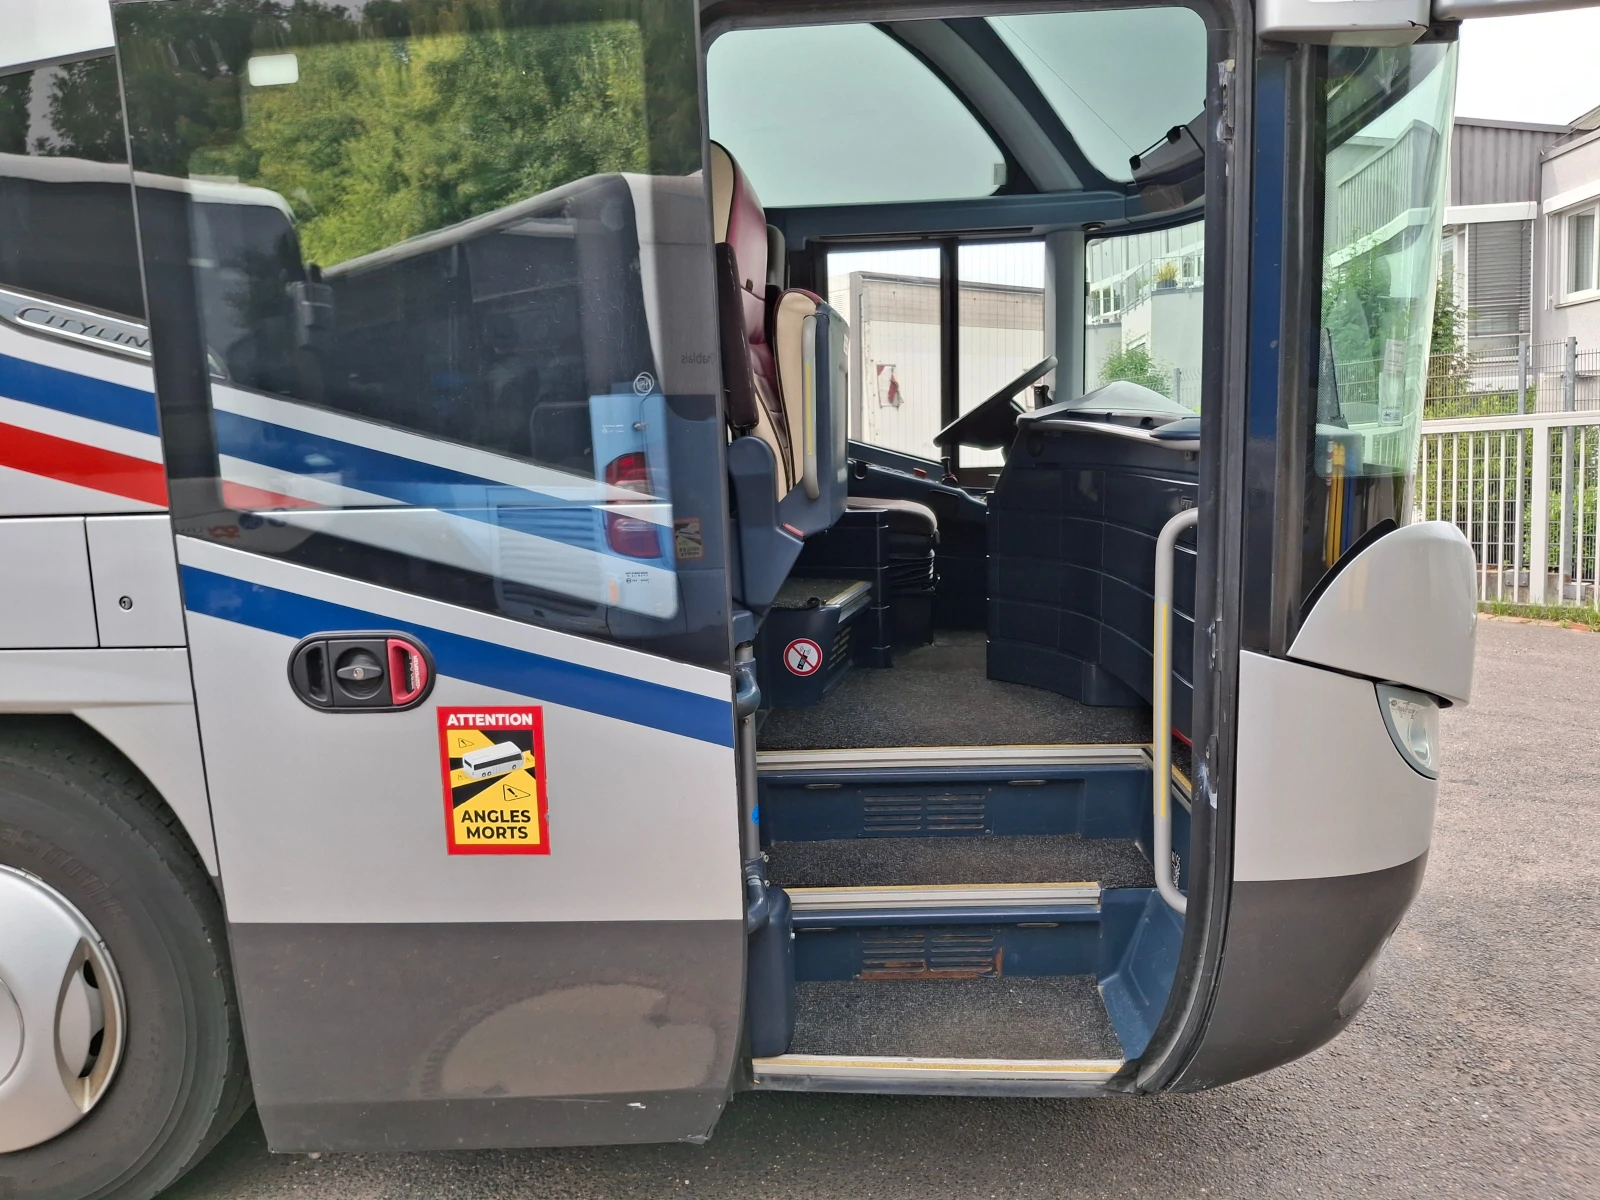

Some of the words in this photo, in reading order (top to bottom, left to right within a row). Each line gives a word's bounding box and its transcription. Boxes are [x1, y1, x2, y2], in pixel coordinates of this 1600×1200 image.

[447, 713, 533, 726] ATTENTION
[461, 810, 531, 823] ANGLES
[466, 826, 528, 839] MORTS
